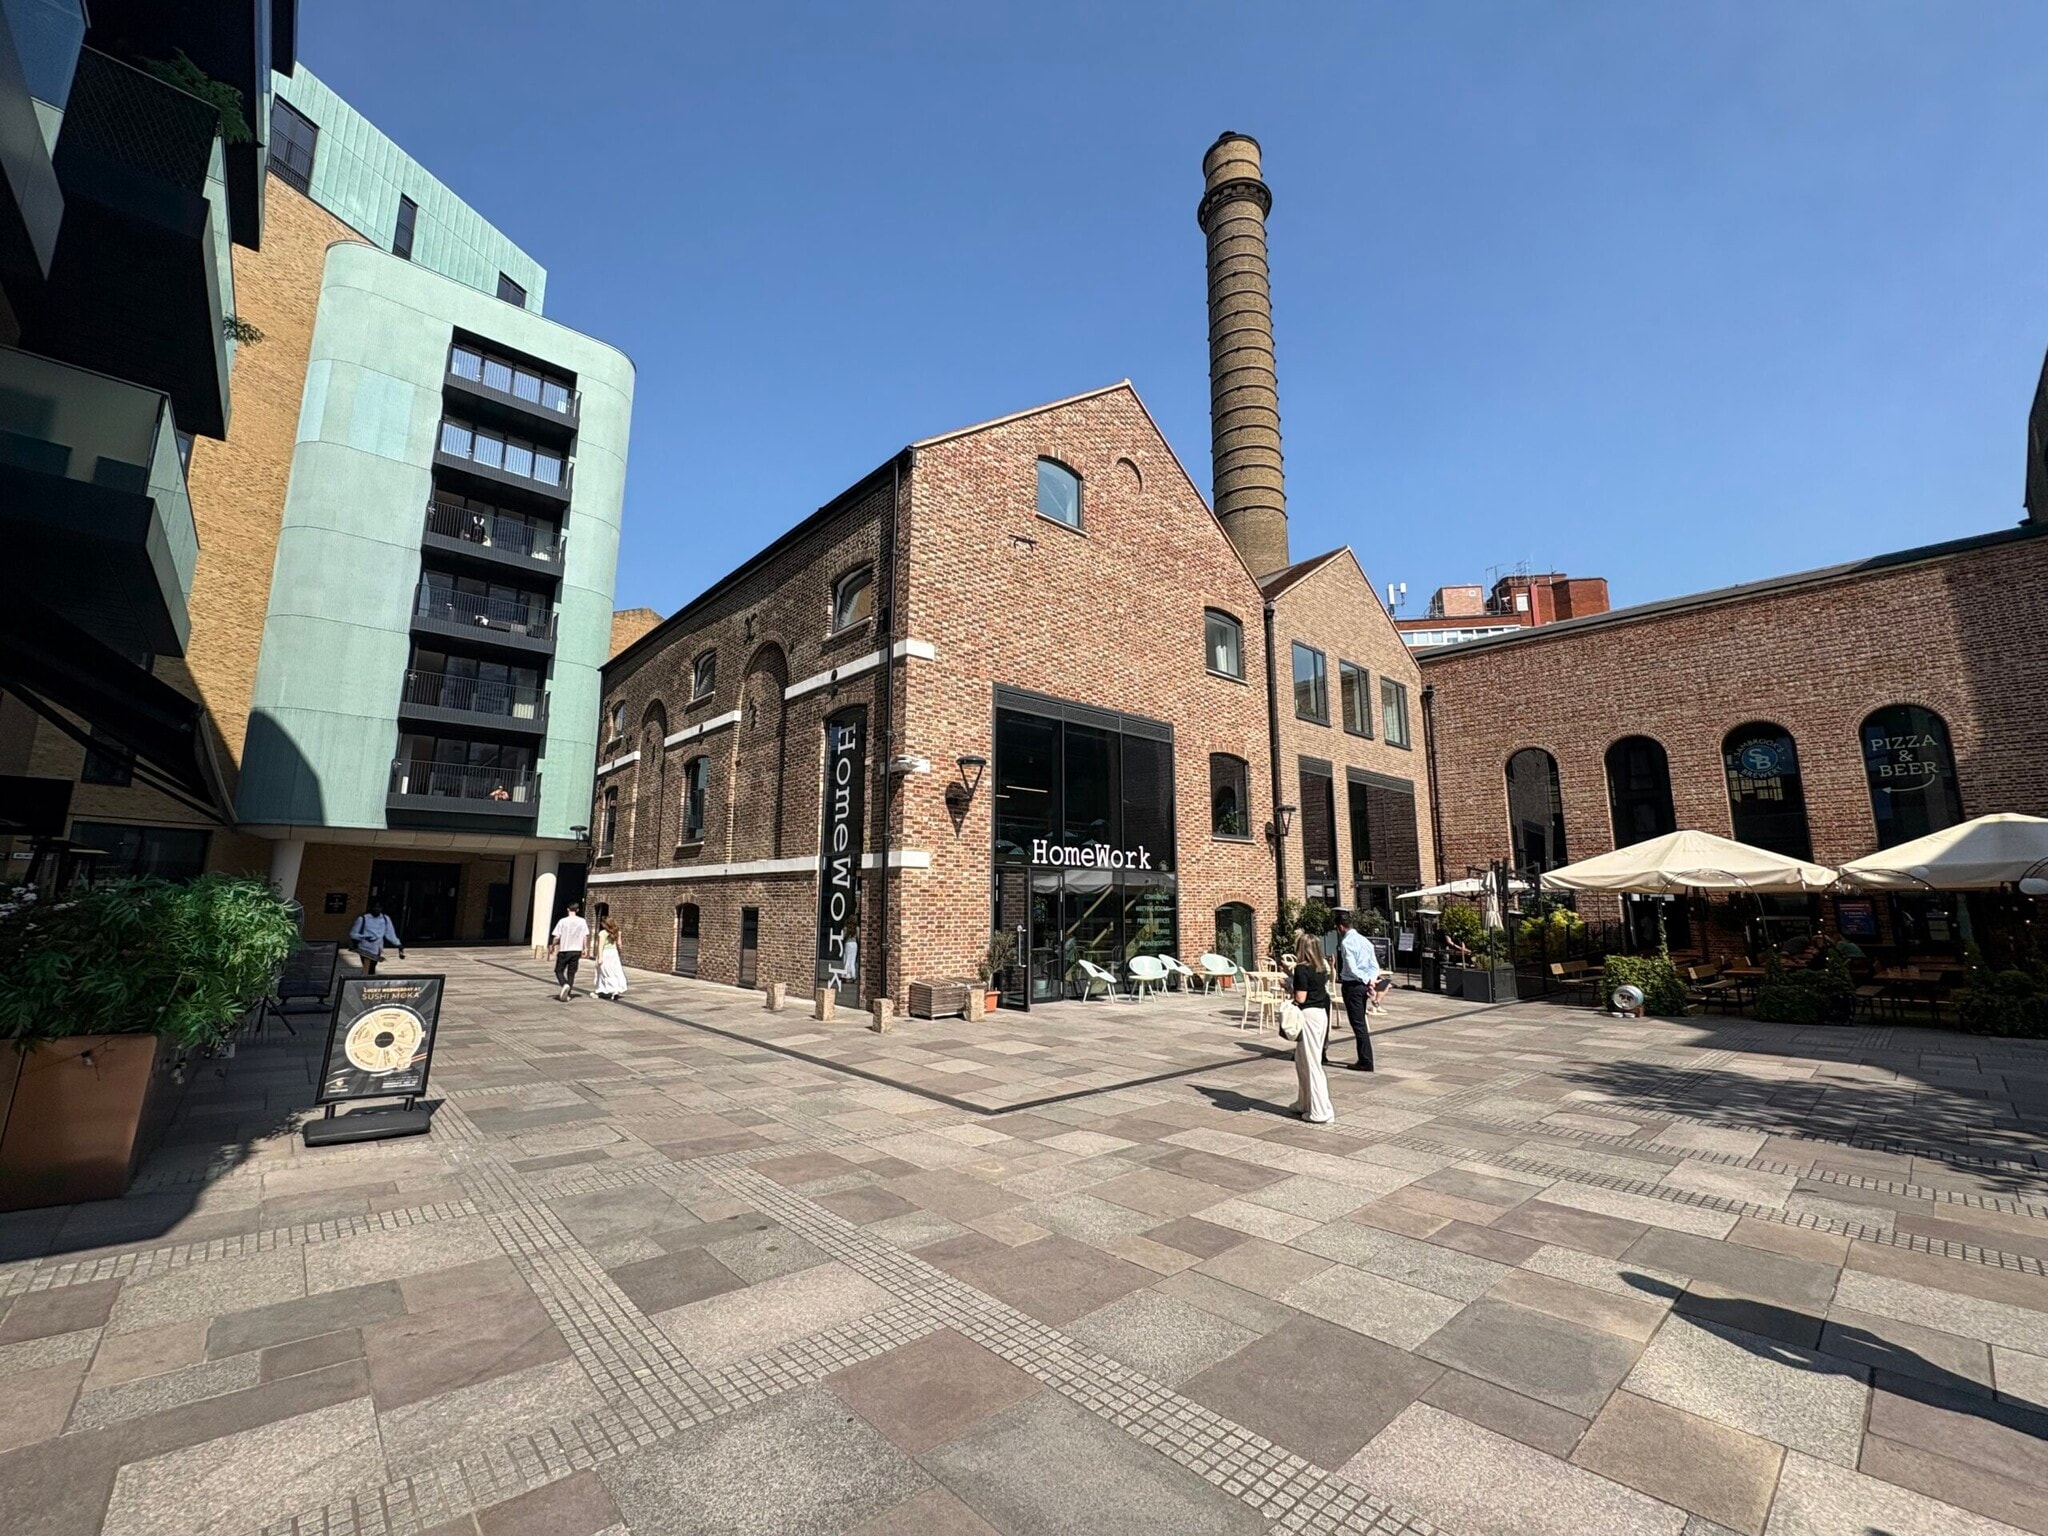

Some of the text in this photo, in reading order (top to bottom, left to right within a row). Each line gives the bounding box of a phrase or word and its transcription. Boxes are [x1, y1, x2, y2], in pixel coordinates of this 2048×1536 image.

[1733, 738, 1785, 757] SAMBROOK'S
[1870, 734, 1938, 751] PIZZA
[1898, 749, 1914, 762] &
[1740, 764, 1783, 779] BREWERY
[1878, 761, 1939, 777] BEER
[1032, 839, 1152, 869] HomeWork
[391, 992, 420, 1000] MOKA
